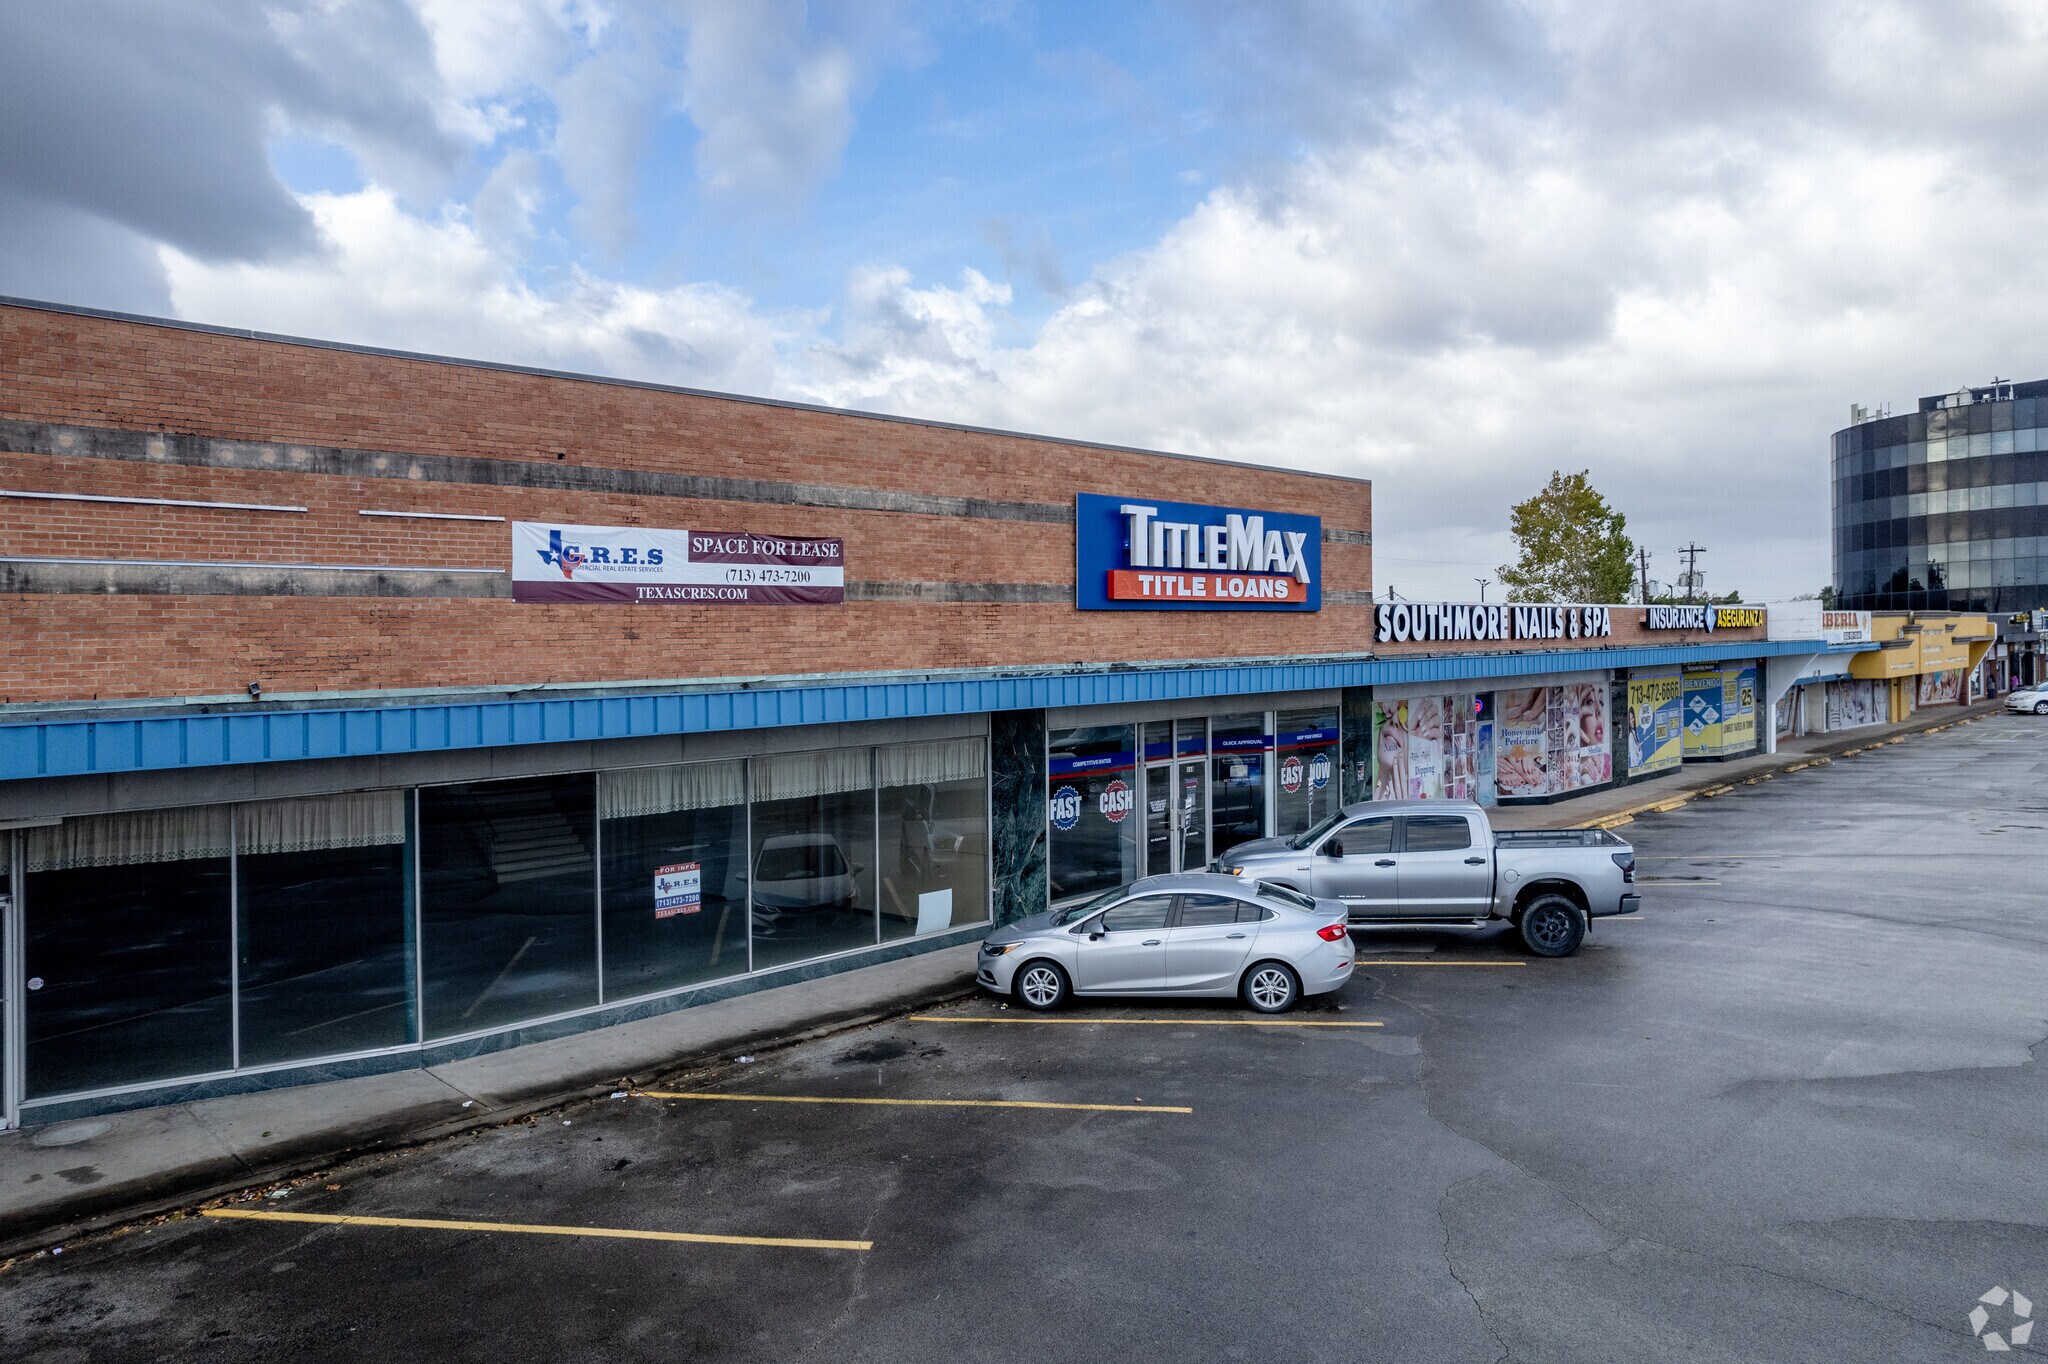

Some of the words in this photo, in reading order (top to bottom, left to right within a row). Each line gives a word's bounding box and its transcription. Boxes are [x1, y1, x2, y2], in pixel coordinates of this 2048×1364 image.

[692, 537, 748, 555] SPACE
[751, 540, 785, 556] FOR
[790, 541, 839, 558] LEASE
[725, 569, 756, 583] (713)
[758, 569, 811, 583] 473-7200
[636, 586, 748, 600] TEXASCRES.COM
[1138, 574, 1206, 597] TITLE
[1215, 577, 1289, 598] LOANS
[1375, 604, 1509, 642] SOUTHMORE
[1512, 607, 1564, 639] NAILS
[1566, 608, 1578, 639] &
[1581, 607, 1612, 637] SPA
[1648, 608, 1704, 630] INSURANCE
[1717, 609, 1763, 628] ASEGURANZA
[1823, 612, 1858, 627] BERIA
[1684, 678, 1720, 688] BIENVENIDO
[1631, 681, 1679, 704] 713-472-6666
[1502, 728, 1523, 737] Honey
[1526, 727, 1541, 736] milk
[1505, 736, 1538, 746] Pedicure
[1072, 759, 1098, 768] COMPETITIVE
[1098, 757, 1112, 765] RATES
[1281, 765, 1303, 785] EASY
[1309, 761, 1331, 780] NOW
[1415, 764, 1435, 777] Dipping
[1050, 795, 1082, 821] FAST
[1099, 789, 1133, 814] CASH
[657, 898, 671, 908] (713)
[672, 894, 699, 904] 473-7200
[657, 905, 700, 917] TEXASCRES.COM
